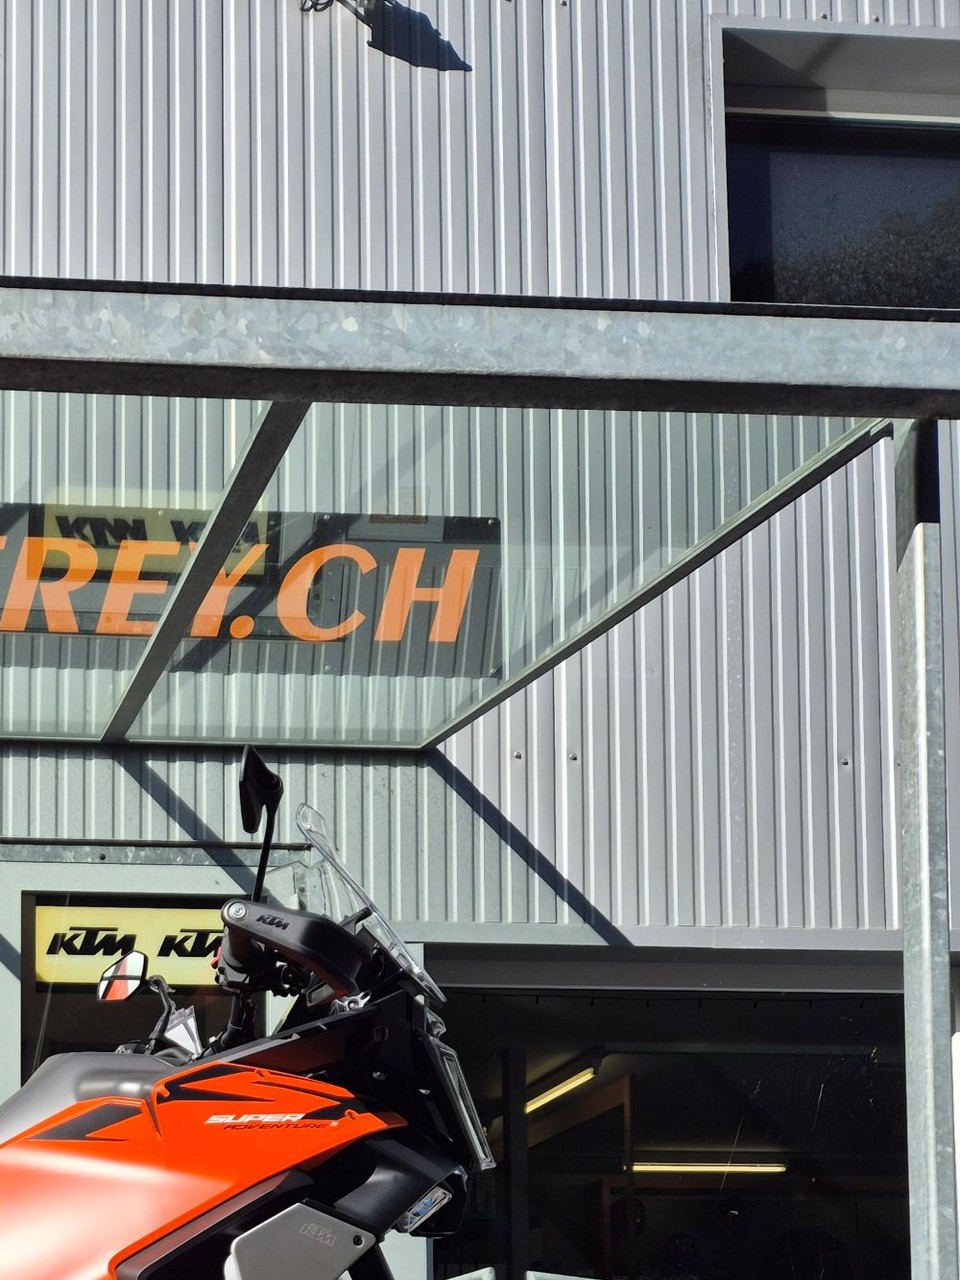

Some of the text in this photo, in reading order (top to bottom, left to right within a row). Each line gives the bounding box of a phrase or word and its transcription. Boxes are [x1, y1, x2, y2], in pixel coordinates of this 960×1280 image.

[256, 914, 290, 930] KTM
[46, 927, 137, 956] KTM
[204, 1113, 305, 1124] SUPER
